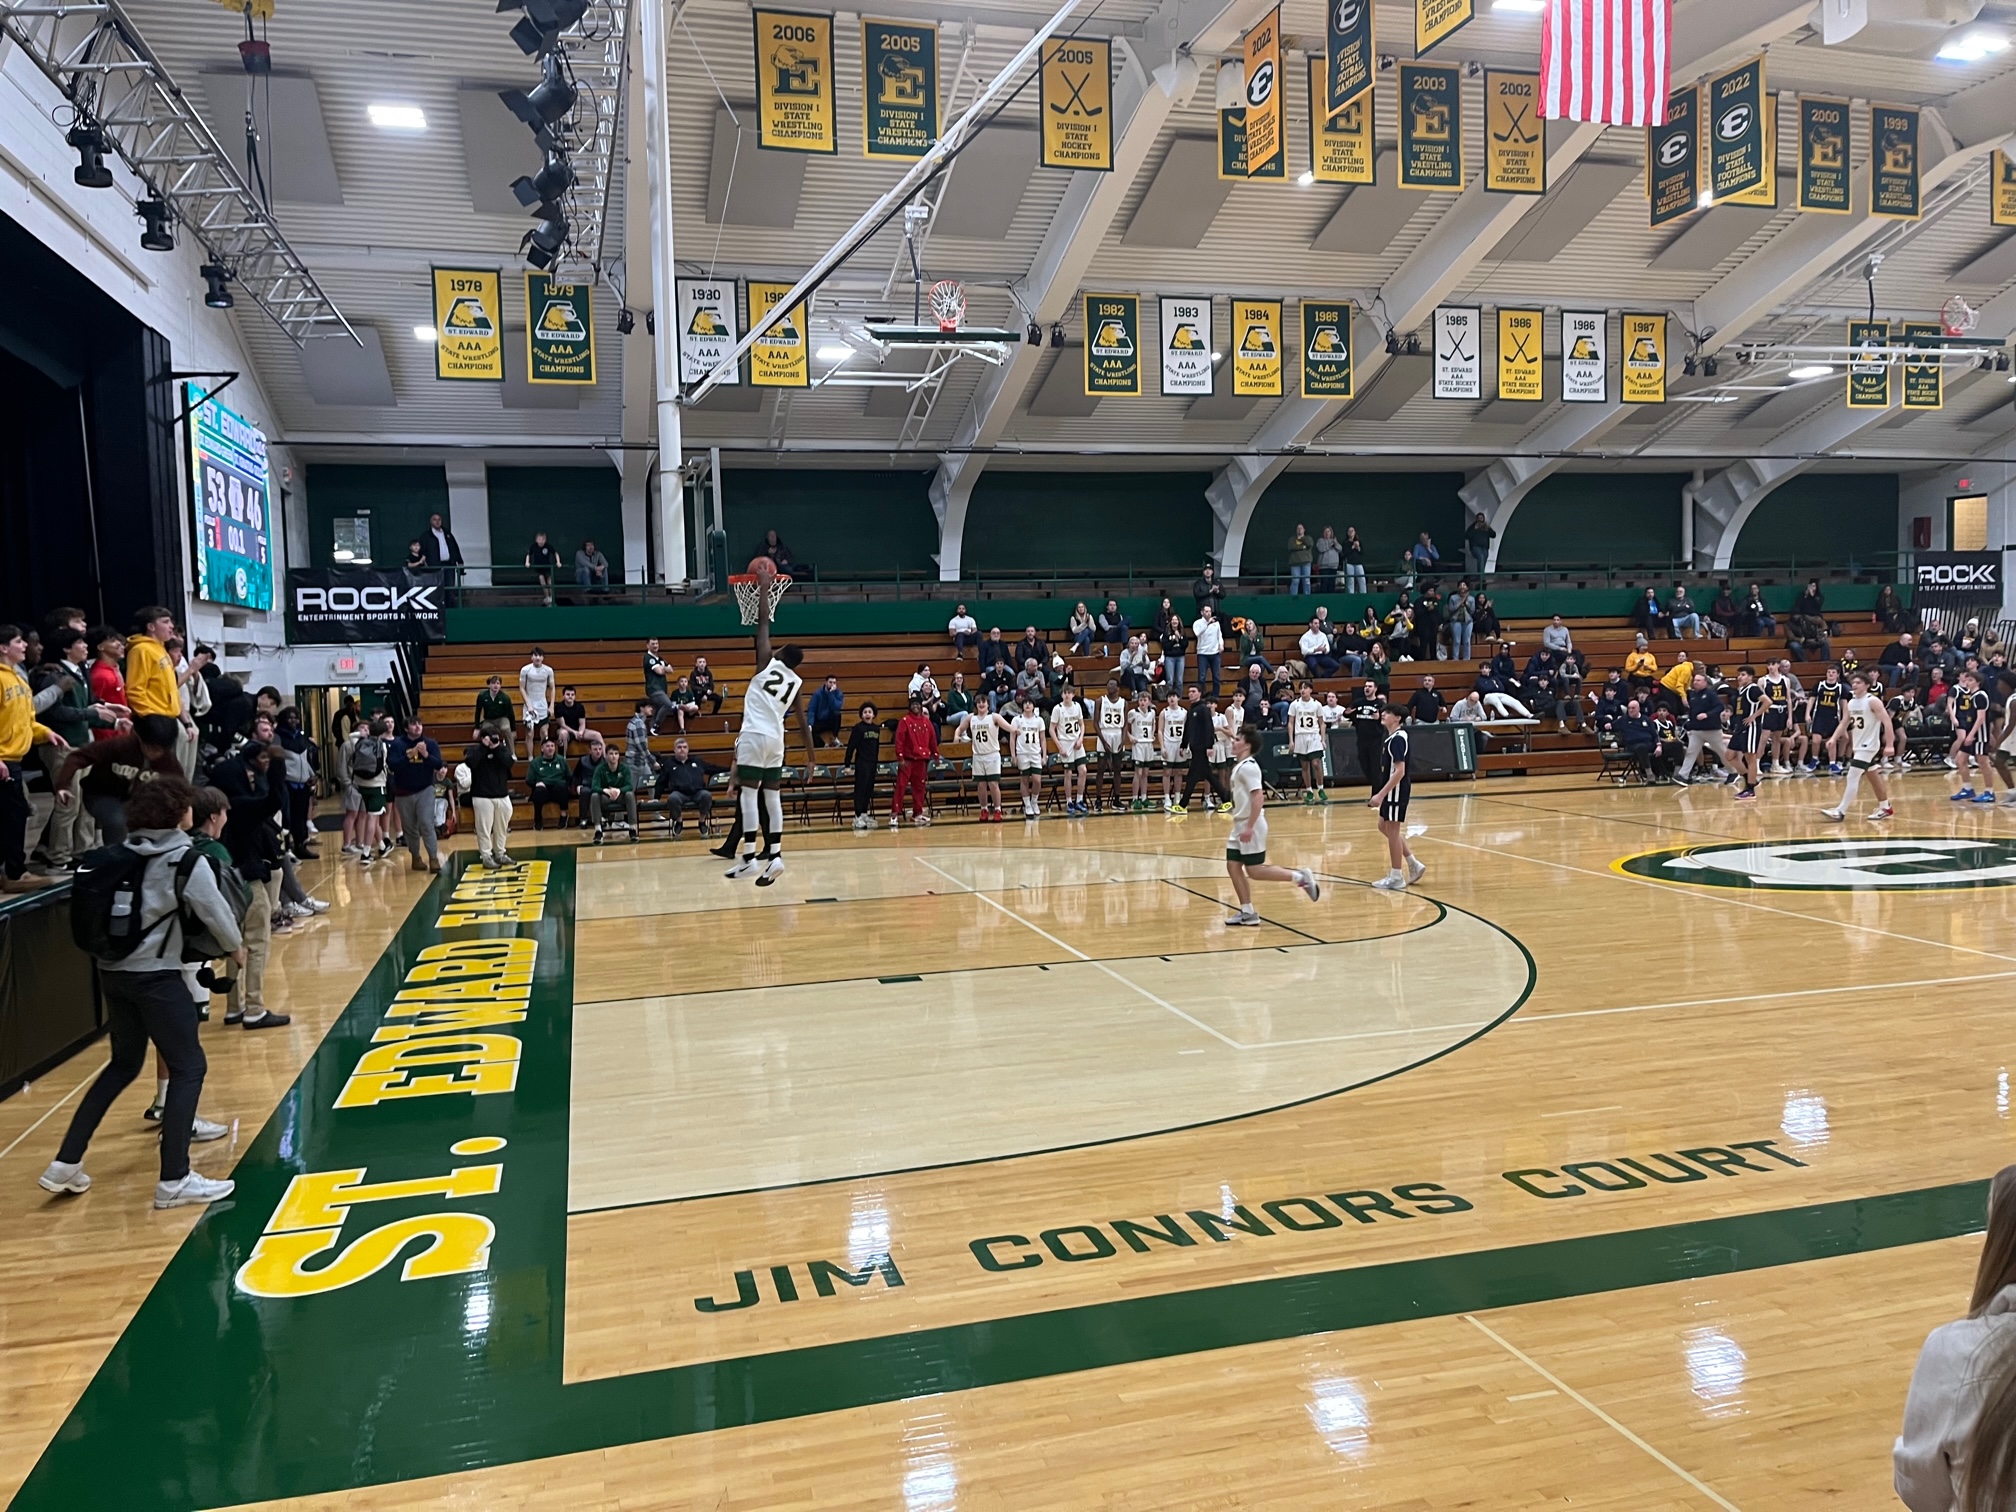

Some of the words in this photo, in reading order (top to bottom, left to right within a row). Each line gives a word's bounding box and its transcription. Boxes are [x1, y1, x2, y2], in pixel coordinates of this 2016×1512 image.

[773, 25, 815, 42] 2006
[880, 34, 920, 52] 2005
[1252, 27, 1271, 57] 2022
[1057, 49, 1093, 64] 2005
[1340, 51, 1359, 71] STATE
[1250, 64, 1272, 102] E
[1413, 76, 1446, 90] 2003
[1721, 72, 1750, 98] 2022
[1500, 82, 1531, 96] 2002
[774, 102, 813, 111] DIVISION
[1668, 102, 1687, 122] 022
[784, 112, 810, 120] STATE
[880, 109, 918, 120] DIVISION
[1811, 109, 1840, 123] 2000
[772, 120, 822, 131] WRESTLING
[890, 120, 915, 128] STATE
[1057, 122, 1091, 132] DIVISION
[772, 129, 823, 140] CHAMPIONS
[878, 127, 927, 138] WRESTLING
[1065, 132, 1088, 141] STATE
[878, 136, 927, 147] CHAMPIONS
[1061, 141, 1092, 150] HOCKEY
[1324, 140, 1356, 148] DIVISION
[1413, 144, 1444, 153] DIVISION
[1054, 150, 1100, 160] CHAMPIONS
[1322, 156, 1364, 165] WRESTLING
[1420, 153, 1441, 161] STATE
[1411, 160, 1452, 169] WRESTLING
[1506, 158, 1527, 166] STATE
[1725, 156, 1744, 170] STATE
[1322, 164, 1364, 173] CHAMPIONS
[1410, 168, 1452, 177] CHAMPIONS
[1502, 167, 1530, 175] HOCKEY
[1718, 161, 1753, 181] FOOTBALL
[1495, 175, 1536, 184] CHAMPIONS
[451, 279, 482, 292] 1978
[543, 283, 574, 296] 1979
[692, 289, 721, 300] 1980
[1099, 304, 1125, 316] 1982
[1174, 307, 1199, 318] 1983
[1245, 309, 1269, 320] 1984
[1315, 311, 1338, 322] 1985
[1446, 315, 1467, 326] 1985
[1509, 318, 1531, 328] 1986
[1574, 320, 1595, 330] 1986
[1633, 323, 1655, 333] 1987
[457, 342, 482, 350] AAA
[550, 344, 573, 354] AAA
[440, 344, 459, 359] STATE
[463, 347, 499, 361] WRESTLING
[533, 347, 551, 362] STATE
[554, 349, 590, 364] WRESTLING
[682, 351, 700, 365] STATE
[698, 349, 720, 357] AAA
[768, 351, 789, 359] AAA
[448, 362, 493, 370] CHAMPIONS
[753, 354, 770, 367] STATE
[772, 355, 805, 369] WRESTLING
[1103, 360, 1122, 368] AAA
[1178, 361, 1196, 369] AAA
[1249, 363, 1267, 371] AAA
[539, 364, 584, 373] CHAMPIONS
[1090, 362, 1104, 376] STATE
[1107, 363, 1137, 378] WRESTLING
[1165, 364, 1180, 378] STATE
[1181, 365, 1210, 379] WRESTLING
[1235, 366, 1251, 379] STATE
[1252, 367, 1280, 380] WRESTLING
[1306, 367, 1320, 379] STATE
[1318, 364, 1336, 372] AAA
[207, 465, 227, 517] 53
[246, 487, 262, 532] 46
[208, 528, 214, 548] 3
[1918, 565, 1996, 584] ROCK
[297, 586, 439, 612] ROCK
[298, 613, 364, 621] ENTERTAINMENT
[762, 670, 796, 704] 21
[1104, 713, 1121, 724] 33
[1300, 717, 1313, 728] 13
[1065, 722, 1079, 734] 20
[1142, 728, 1148, 738] 3
[1170, 727, 1183, 737] 15
[976, 731, 988, 742] 45
[1025, 733, 1036, 743] 11
[435, 860, 551, 928] EAGLES
[332, 937, 539, 1110] EDWARD
[234, 1135, 508, 1299] ST.
[693, 1252, 906, 1313] JIM
[968, 1182, 1474, 1272] CONNORS
[1502, 1139, 1810, 1199] COURT
